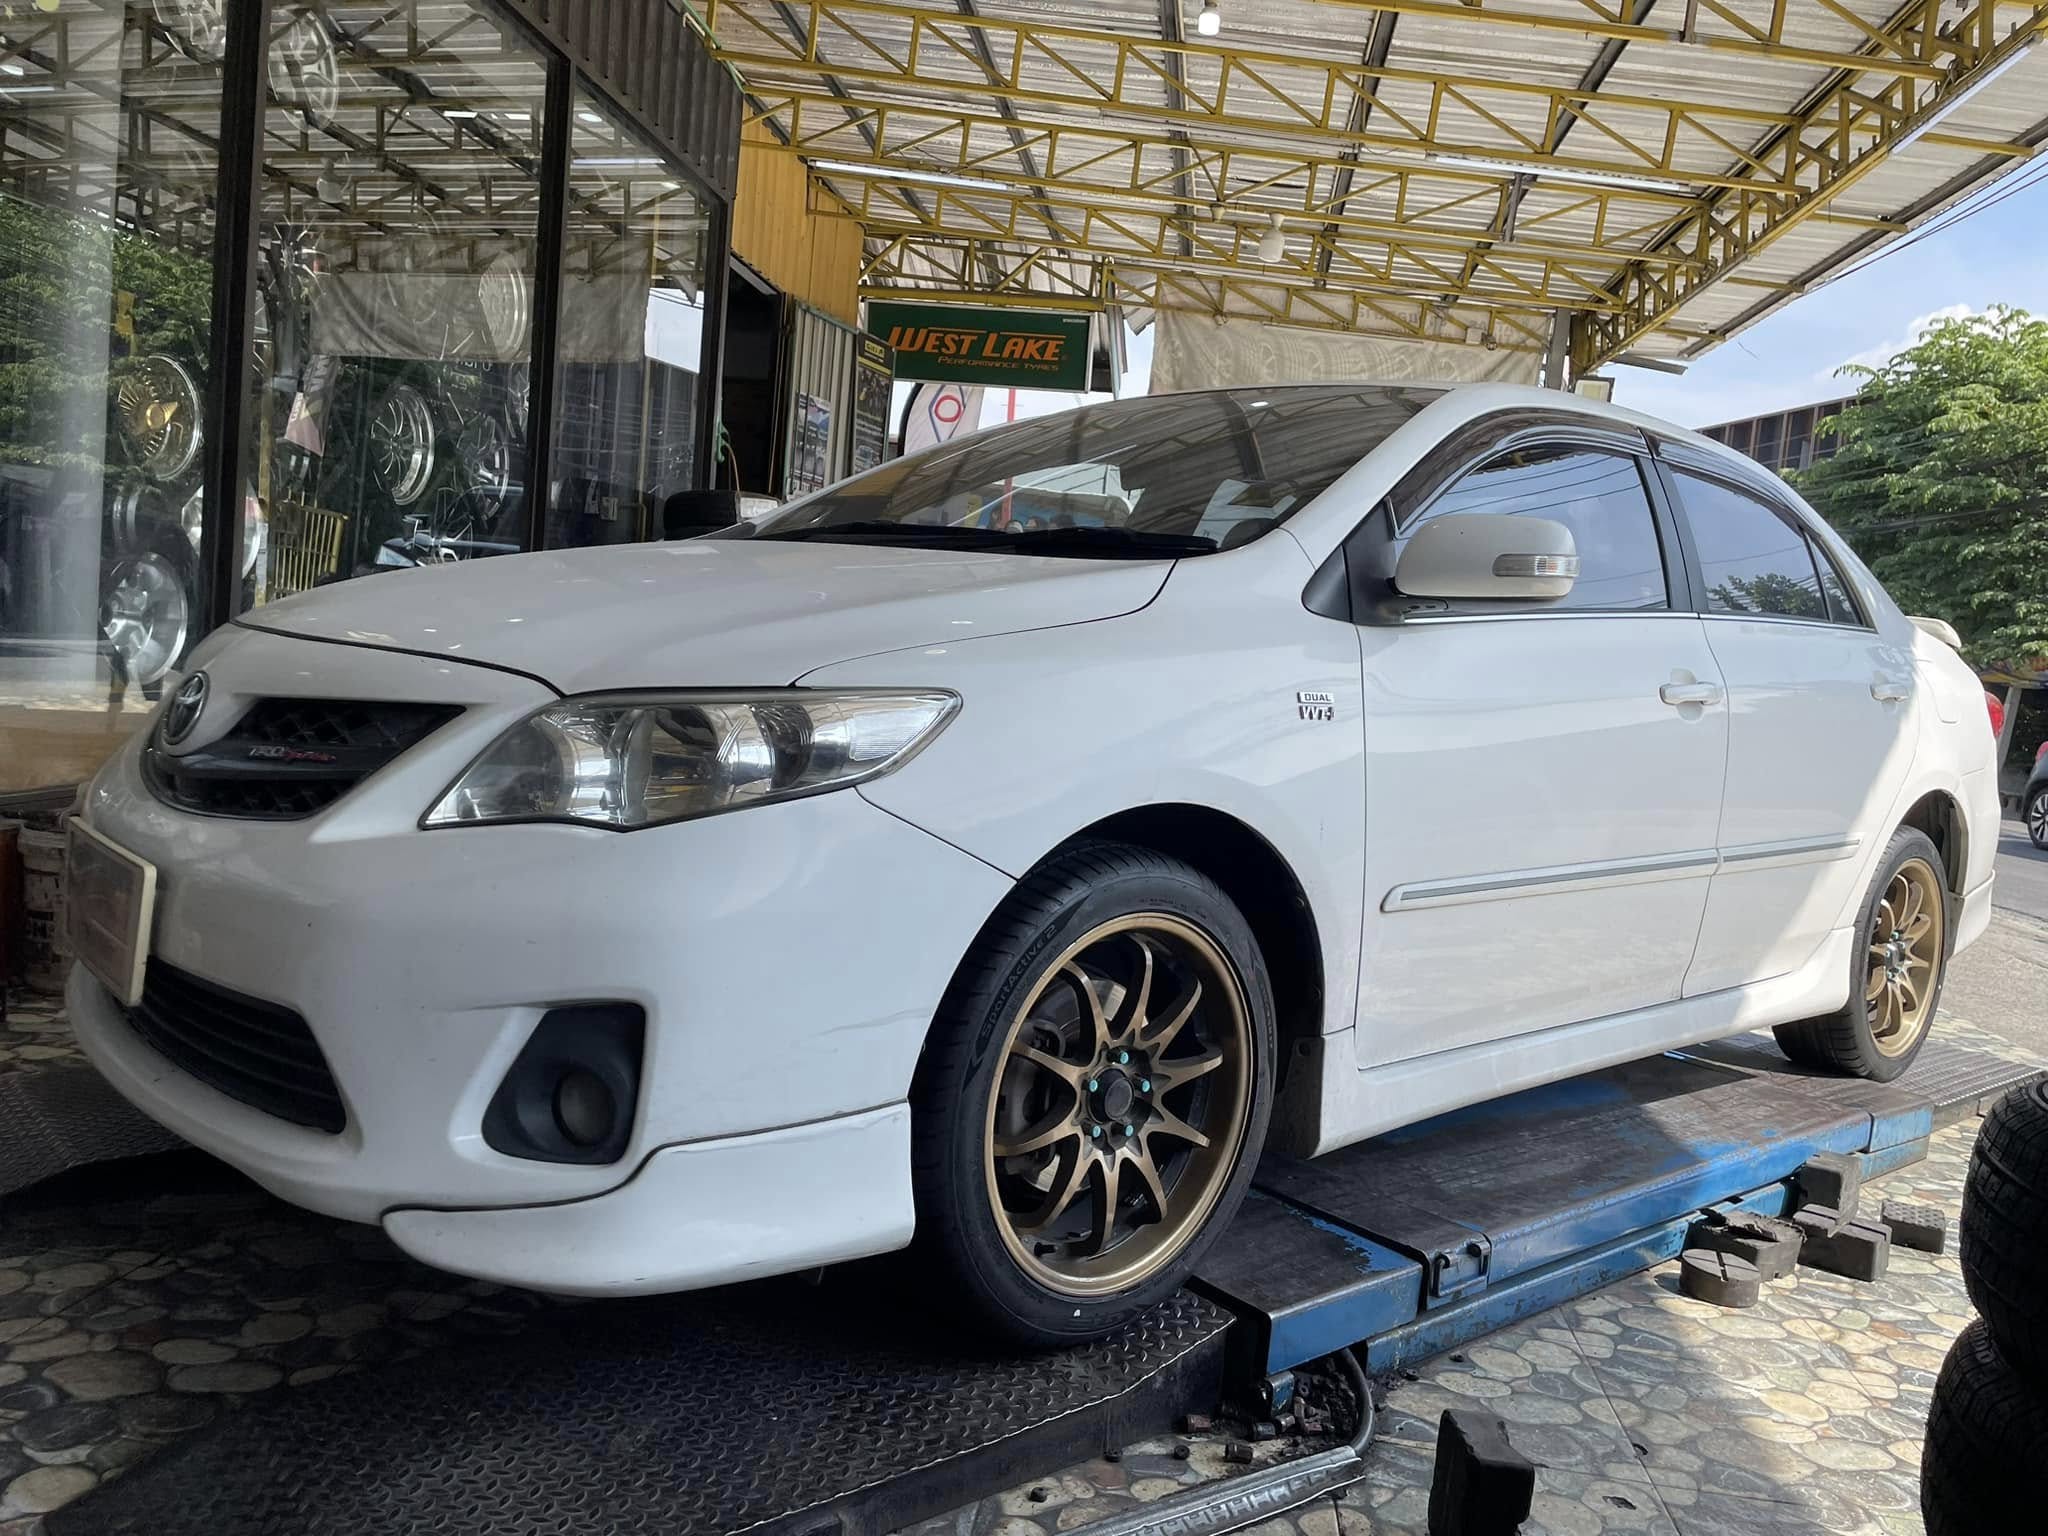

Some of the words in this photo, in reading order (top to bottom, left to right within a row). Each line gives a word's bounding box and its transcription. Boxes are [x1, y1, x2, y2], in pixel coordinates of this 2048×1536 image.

[887, 326, 978, 355] WEST
[982, 331, 1065, 362] LAKE
[937, 355, 1018, 370] PERFORMANCE
[1024, 363, 1060, 373] TYRES
[1303, 692, 1332, 702] DUAL
